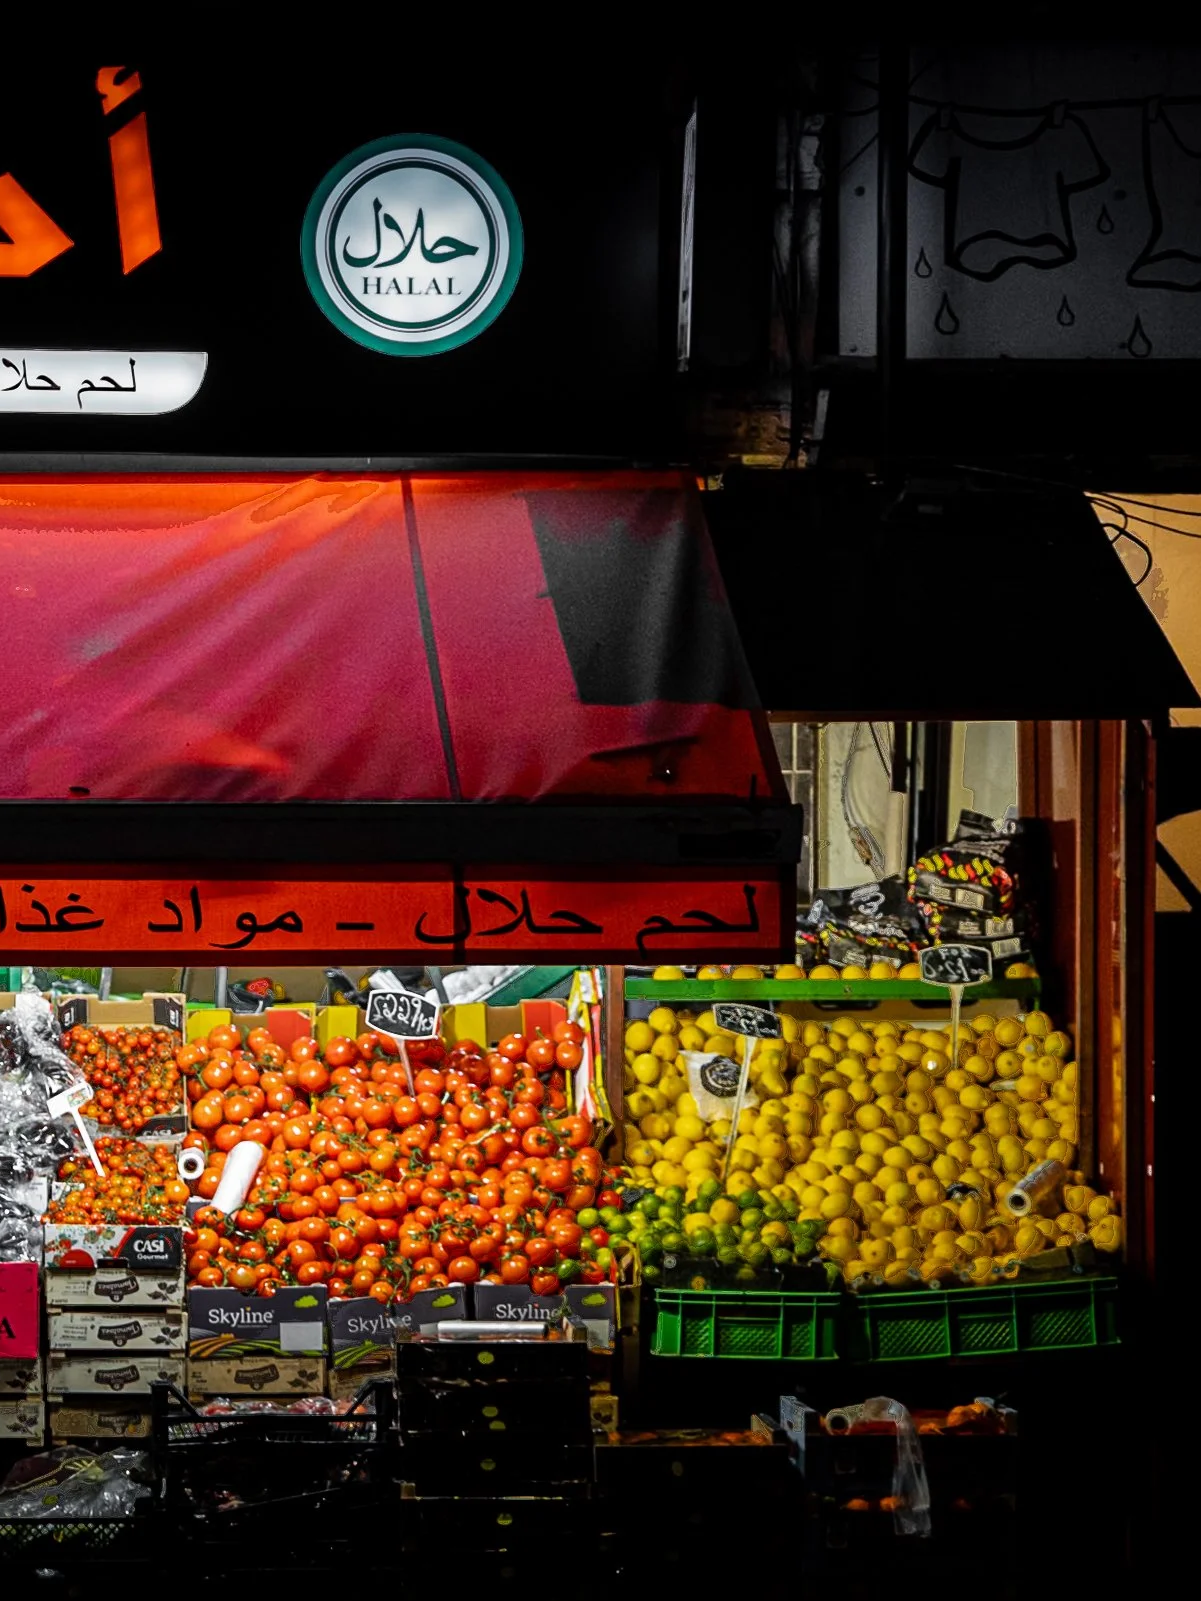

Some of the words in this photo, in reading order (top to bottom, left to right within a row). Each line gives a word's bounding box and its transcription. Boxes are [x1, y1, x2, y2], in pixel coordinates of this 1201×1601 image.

[341, 196, 480, 269] حلال
[360, 275, 462, 296] HALAL
[75, 359, 137, 410] لحم
[144, 886, 305, 950] مواد
[414, 886, 604, 944] حلال
[635, 883, 761, 961] لحم
[133, 1239, 165, 1253] CASI
[207, 1306, 274, 1328] Skyline
